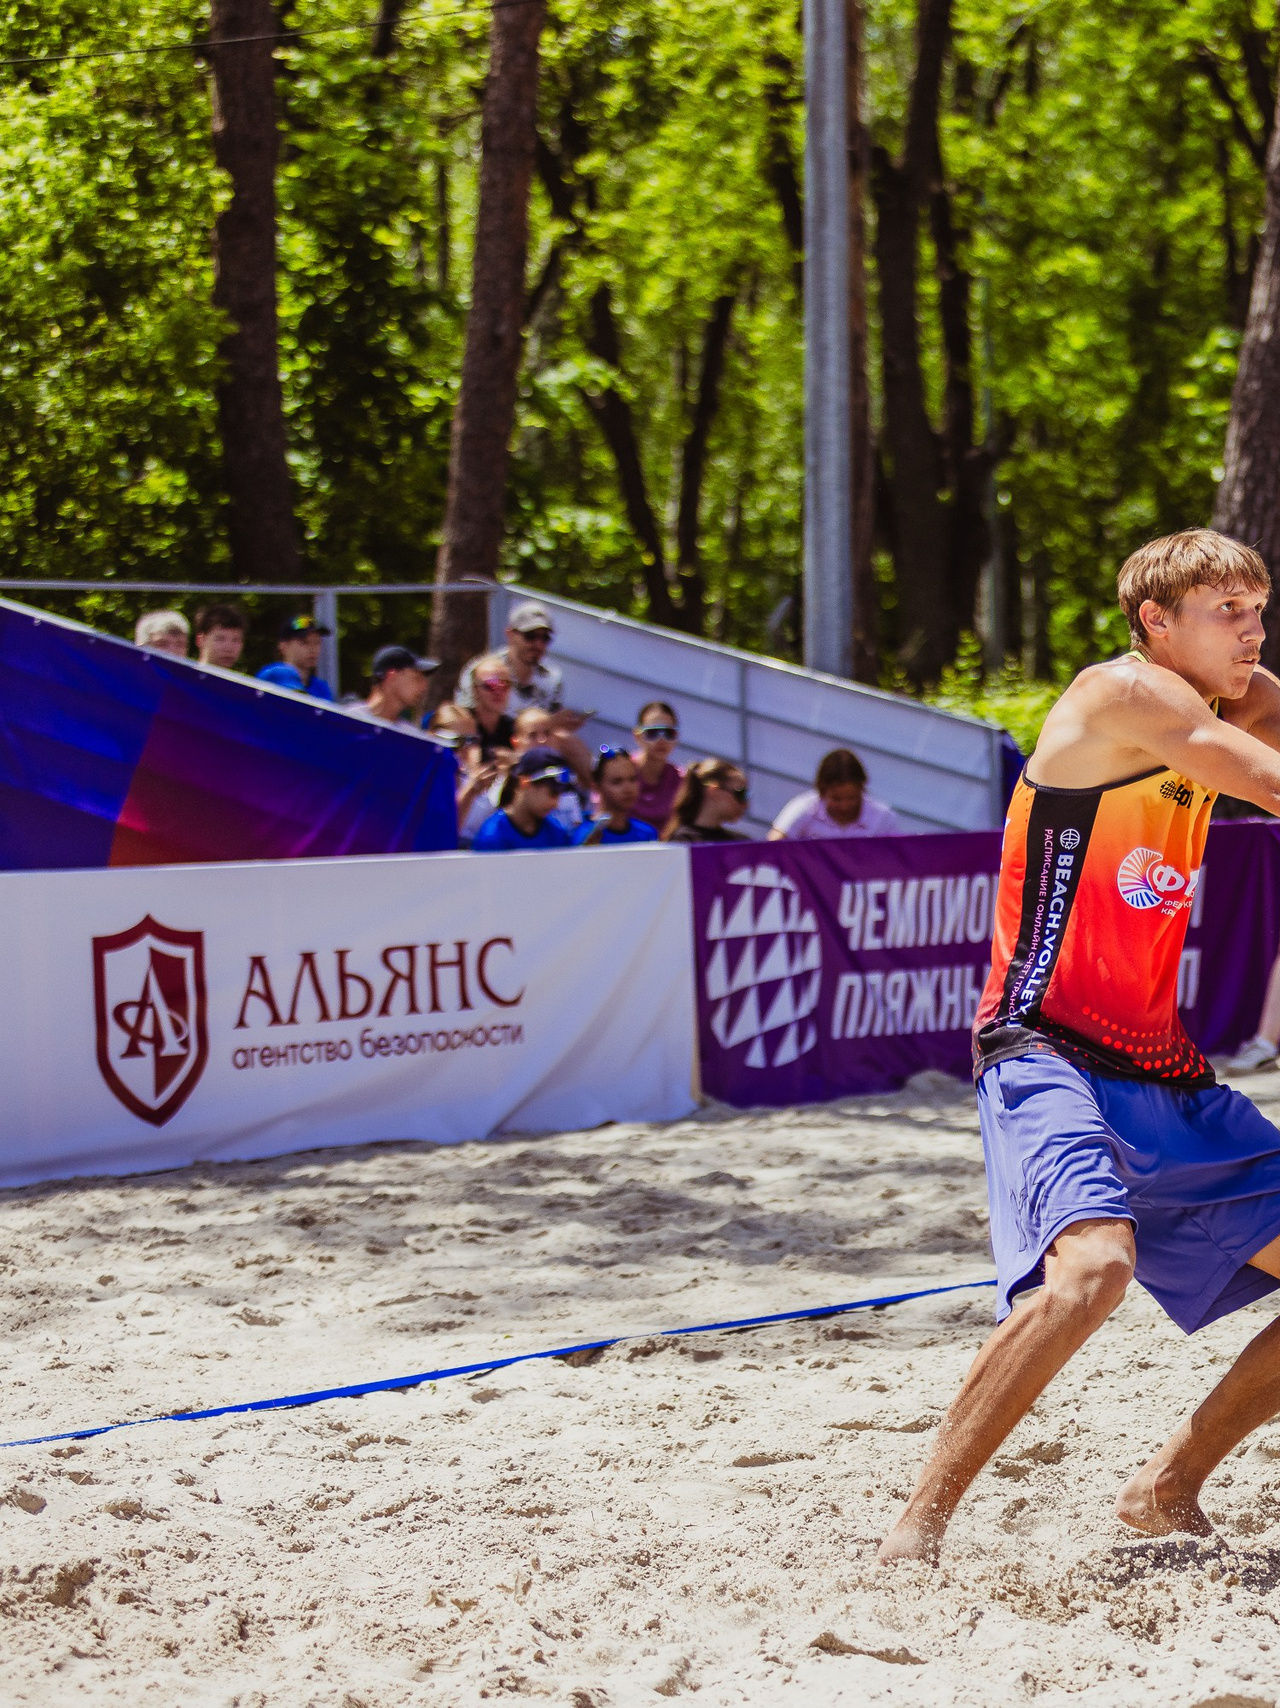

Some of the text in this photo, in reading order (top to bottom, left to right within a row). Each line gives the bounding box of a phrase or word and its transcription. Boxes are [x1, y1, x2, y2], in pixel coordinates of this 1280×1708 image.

[1038, 828, 1054, 897] РАСПИСАНИЕ
[1030, 904, 1045, 950] ОНЛАЙН
[233, 937, 527, 1030] АЛЬЯНС
[1021, 951, 1036, 976] СЧЕТ
[231, 1023, 526, 1070] агентство безопасности
